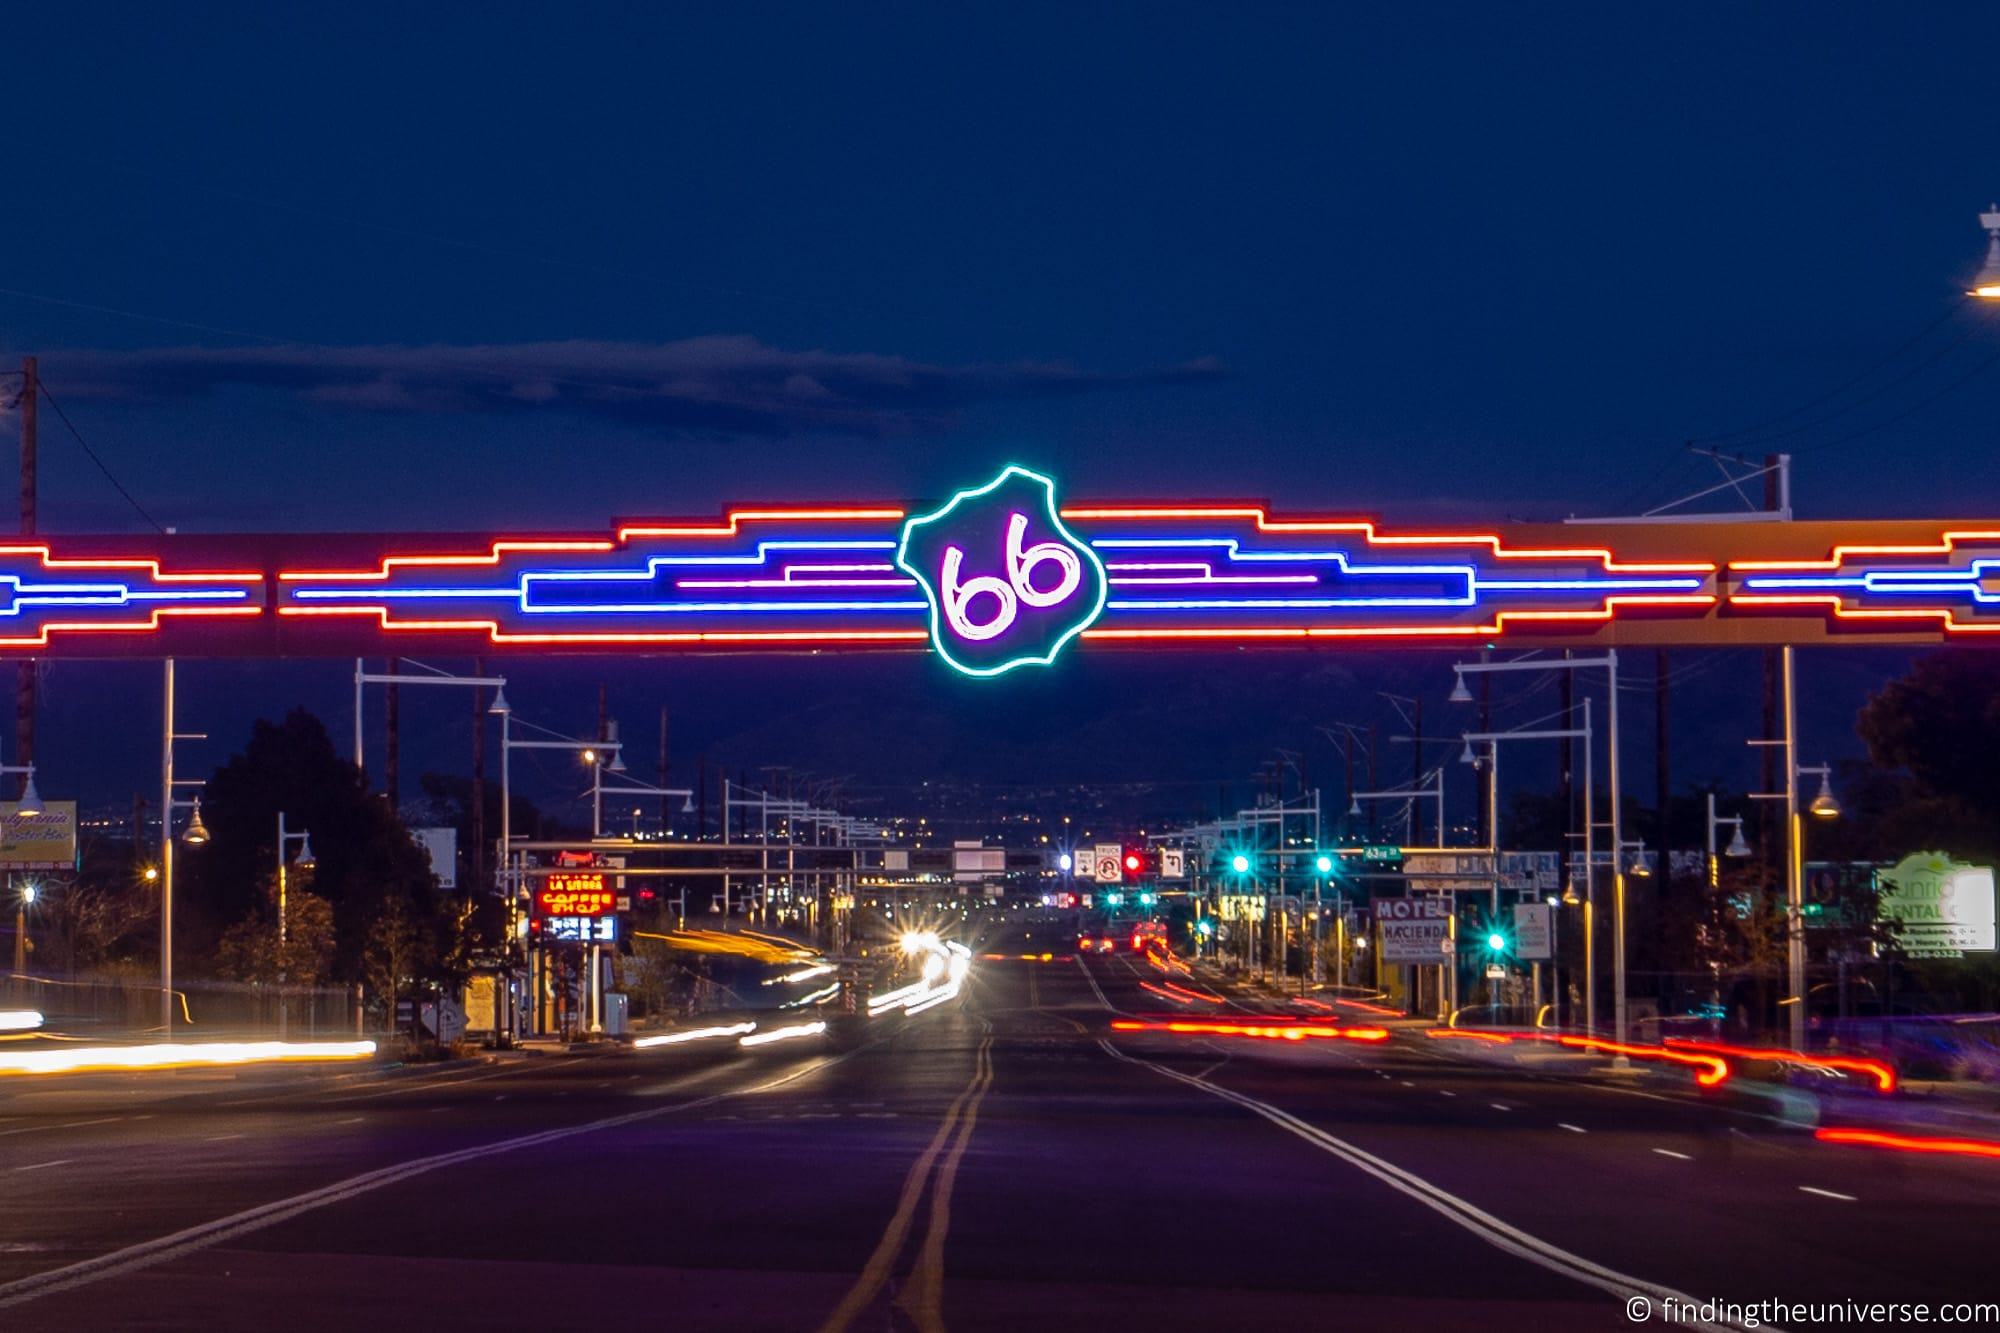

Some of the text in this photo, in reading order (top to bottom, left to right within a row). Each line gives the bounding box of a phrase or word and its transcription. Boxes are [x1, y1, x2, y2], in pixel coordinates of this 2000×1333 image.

[940, 512, 1081, 641] 66
[549, 880, 603, 892] LA SIERRA
[542, 893, 612, 904] COFFEE
[551, 903, 601, 914] SHOP
[1377, 900, 1450, 918] MOTEL
[1384, 925, 1449, 939] HACIENDA
